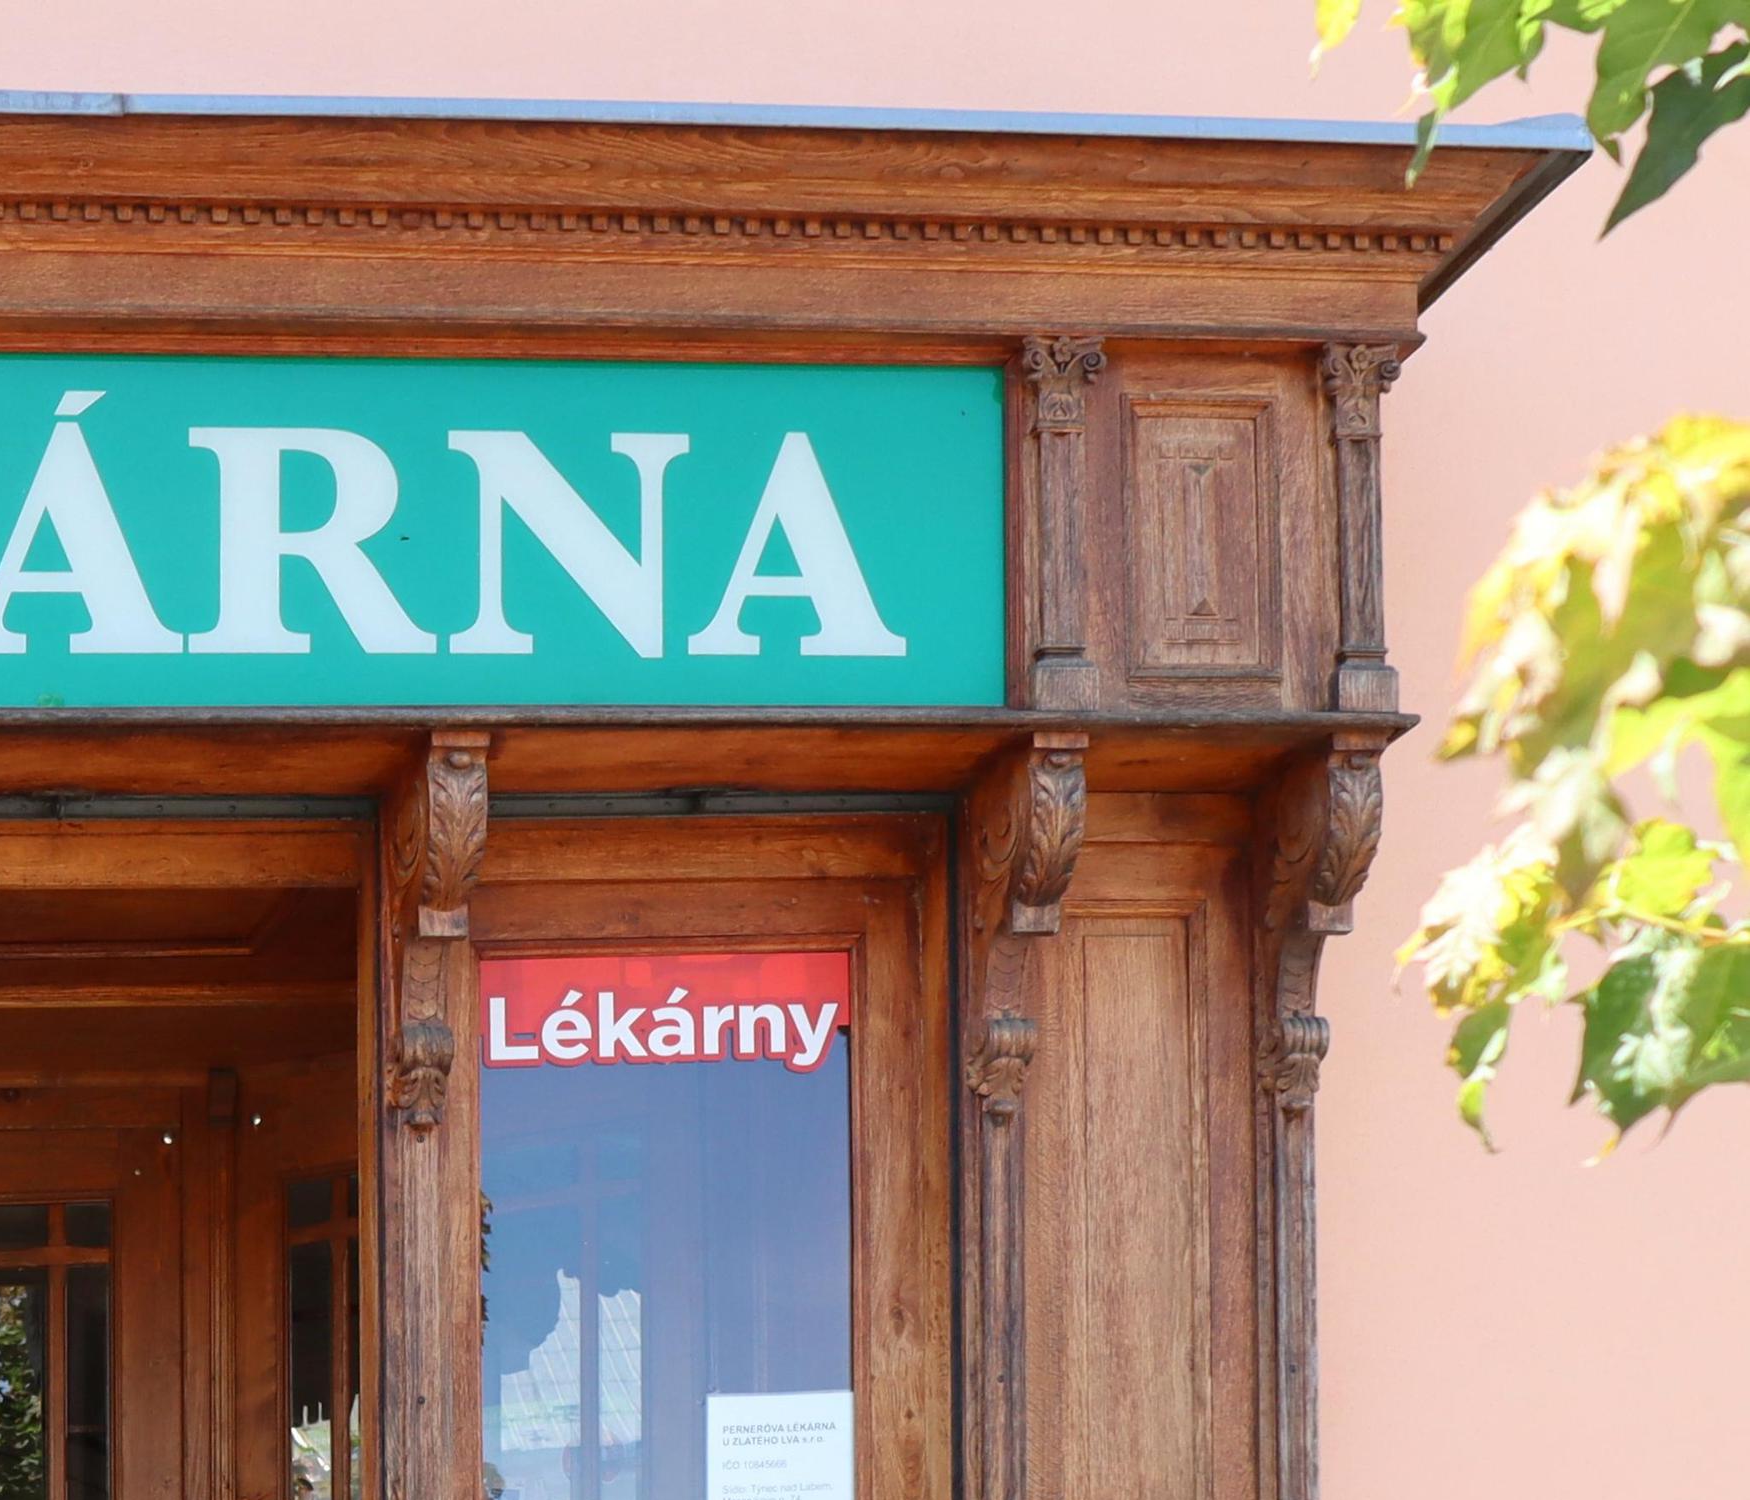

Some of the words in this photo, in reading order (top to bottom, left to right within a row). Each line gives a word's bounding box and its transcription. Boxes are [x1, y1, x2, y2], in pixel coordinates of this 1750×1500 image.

[489, 986, 838, 1066] Lékárny
[722, 1438, 730, 1446] U
[781, 1435, 800, 1445] LVA
